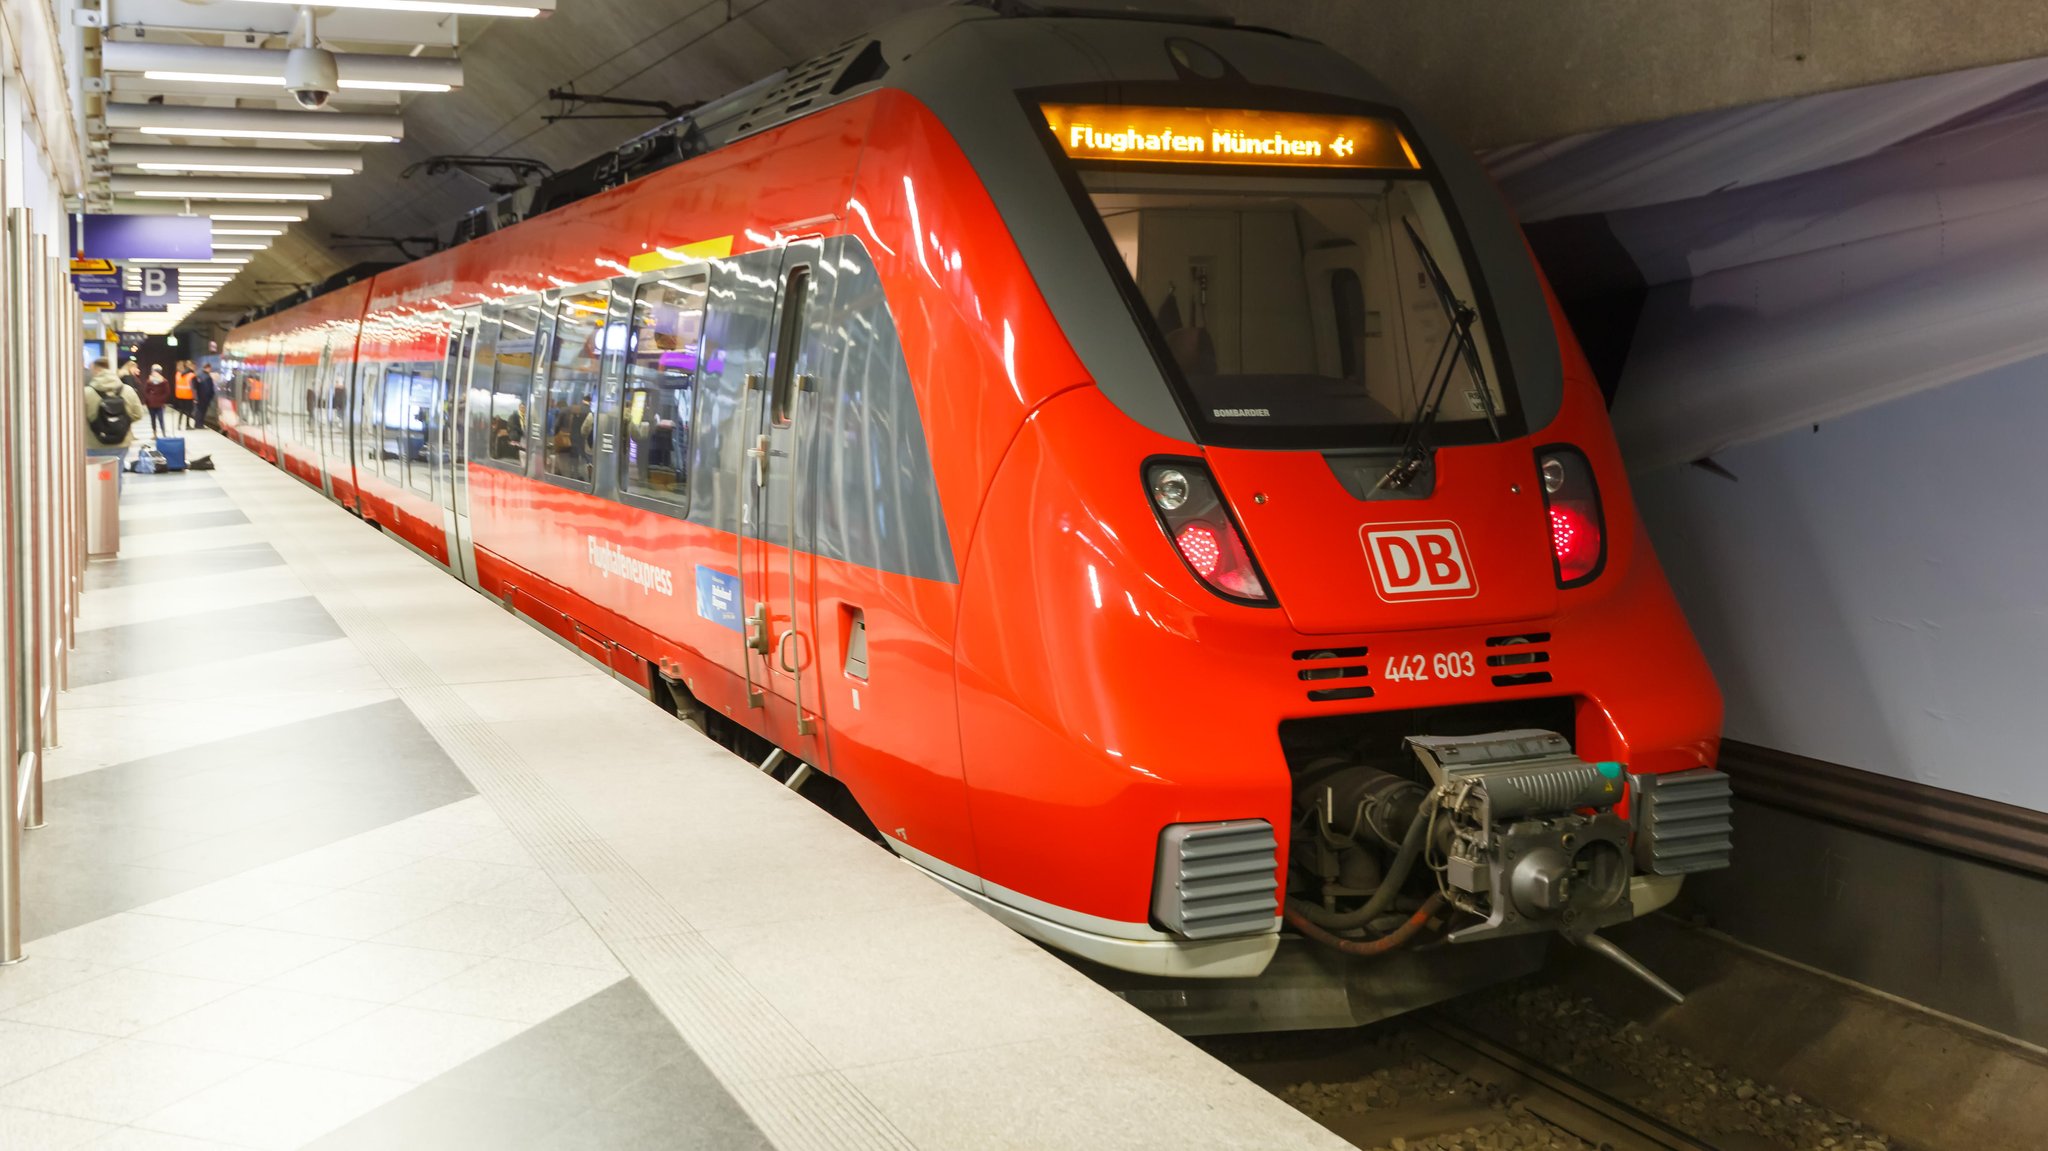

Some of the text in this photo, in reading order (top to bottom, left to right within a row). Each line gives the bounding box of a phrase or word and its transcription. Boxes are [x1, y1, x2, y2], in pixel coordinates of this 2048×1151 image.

[1070, 125, 1321, 156] Flughafen München
[145, 268, 168, 296] B
[1213, 409, 1271, 417] BOMBARDIER
[588, 535, 673, 596] Flughafenexpress
[1376, 534, 1462, 588] DB
[1385, 651, 1476, 682] 442 603
